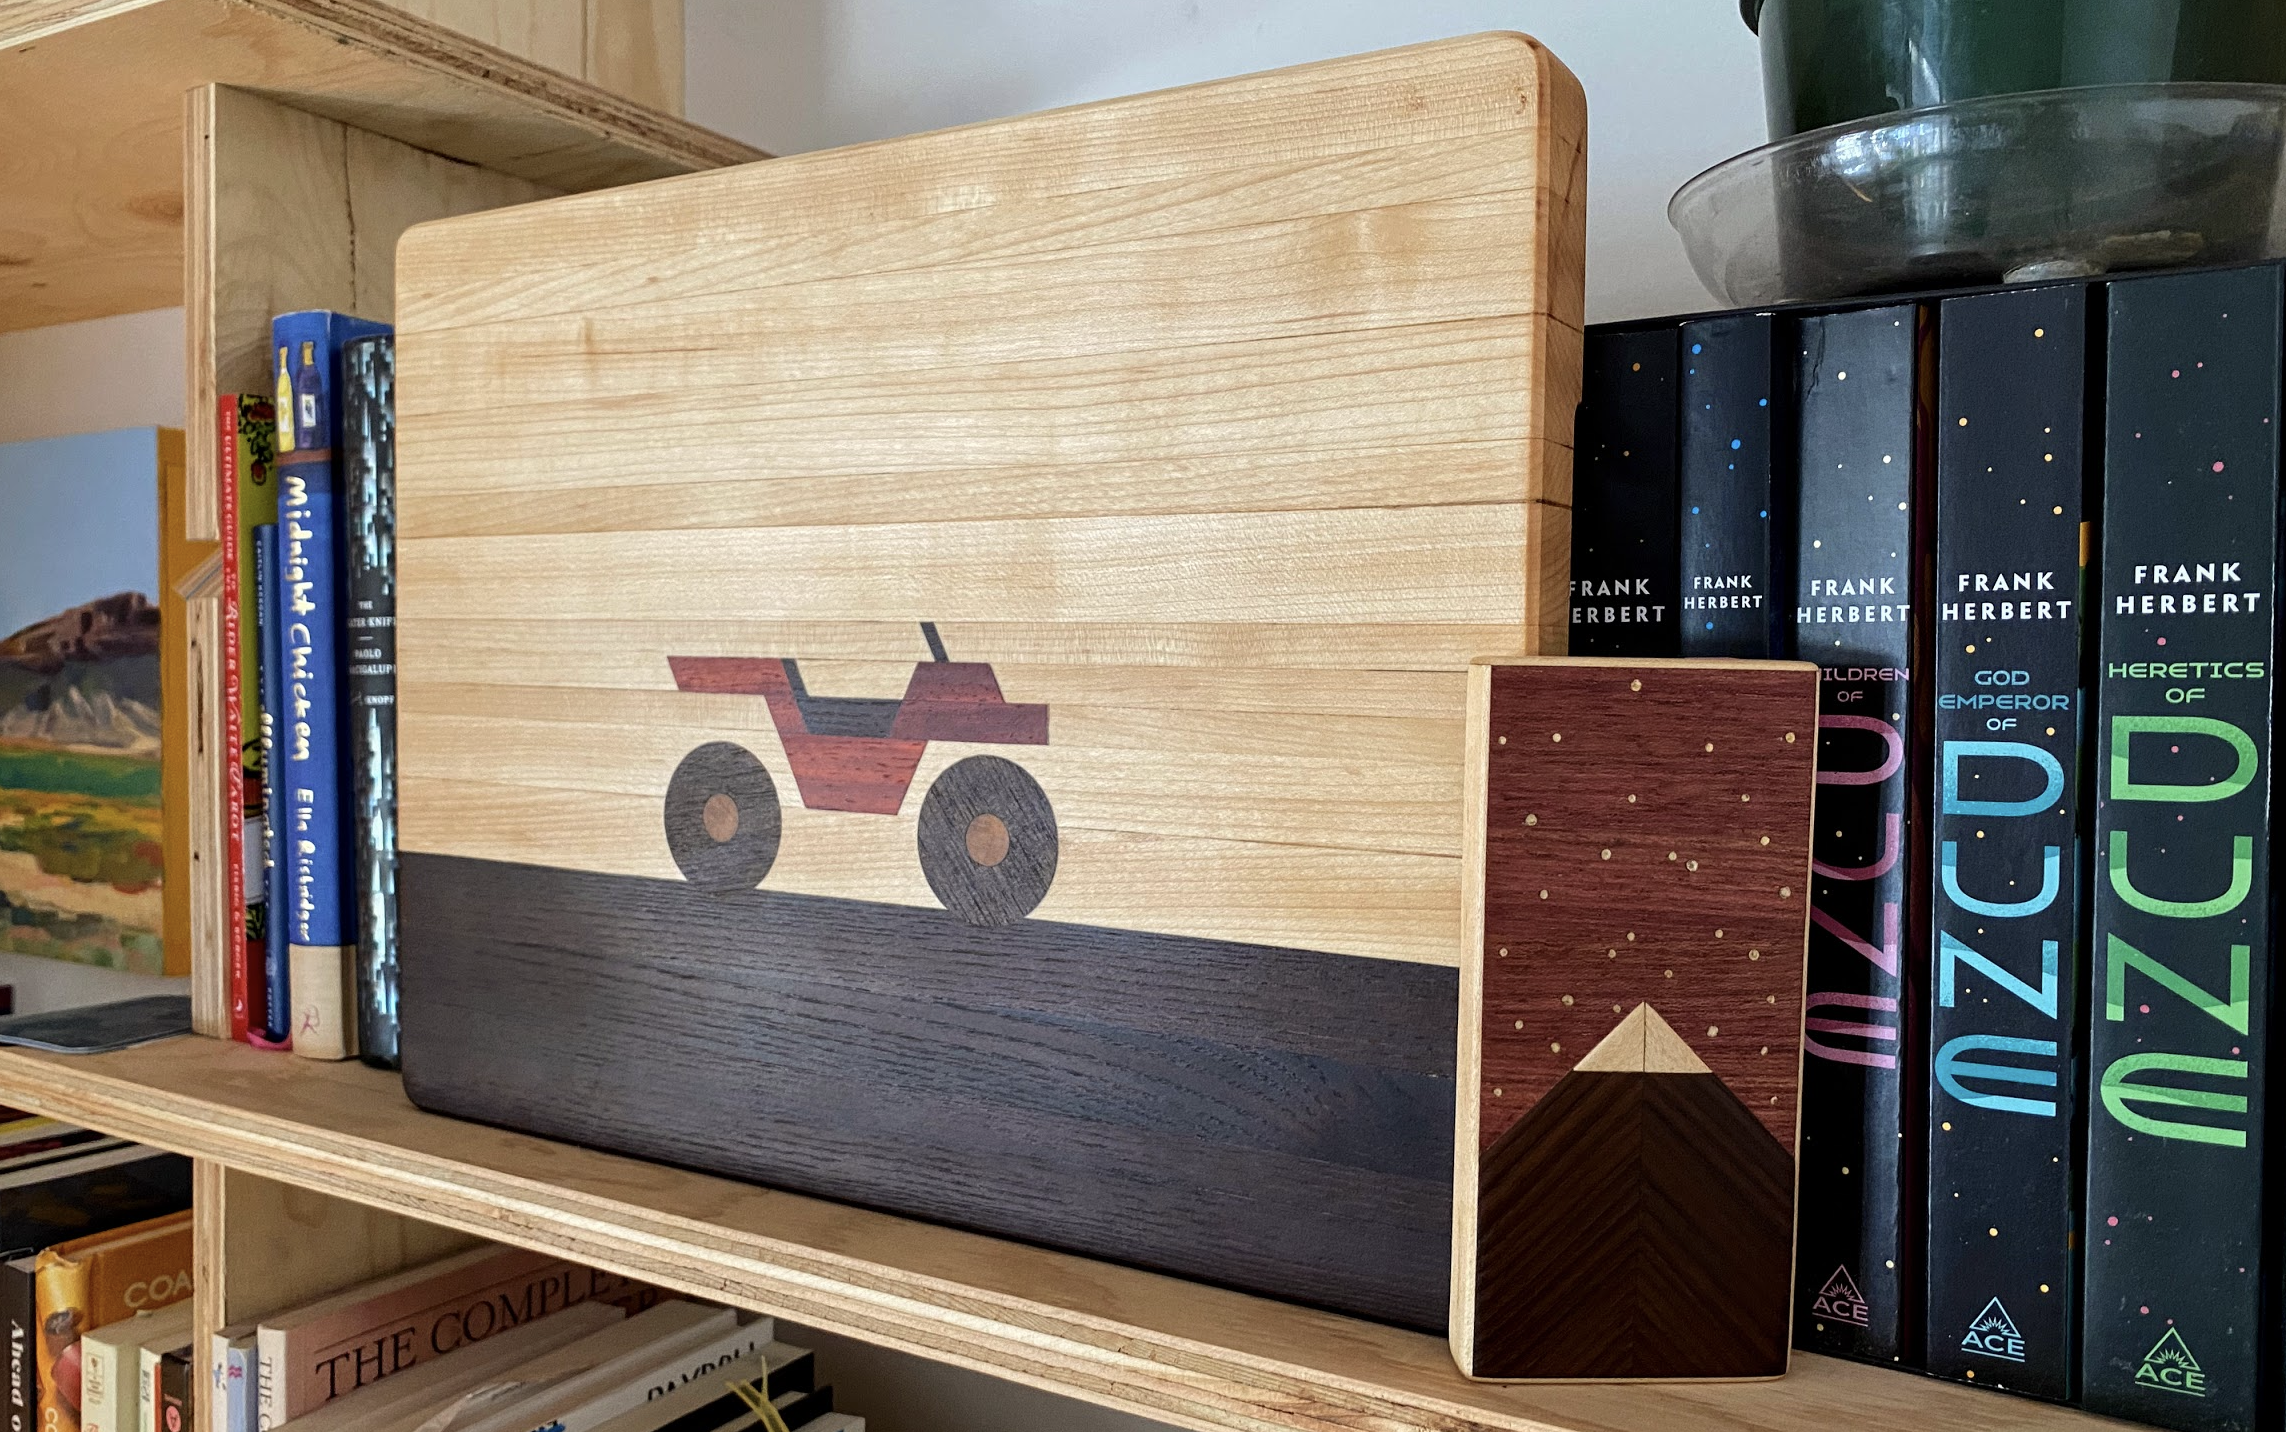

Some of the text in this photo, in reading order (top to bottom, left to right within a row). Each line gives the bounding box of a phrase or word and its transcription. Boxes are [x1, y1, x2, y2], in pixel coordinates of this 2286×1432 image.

[224, 435, 233, 510] ULTIMATE
[226, 514, 234, 560] GUIDE
[1693, 575, 1752, 589] FRANK
[1958, 571, 2055, 592] FRANK
[2134, 562, 2241, 584] FRANK
[1570, 578, 1650, 597] FRANK
[1811, 577, 1895, 596] FRANK
[358, 600, 374, 610] THE
[1684, 595, 1763, 609] HERBERT
[1942, 600, 2072, 621] HERBERT
[2116, 592, 2261, 615] HERBERT
[285, 475, 316, 761] Midnight Chicken
[1572, 605, 1665, 623] ERBERT
[1796, 604, 1910, 623] HERBERT
[354, 648, 382, 659] PAOLO
[1819, 667, 1909, 681] ILDREN
[1974, 669, 2030, 686] GOD
[2108, 662, 2265, 679] HERETICS
[364, 695, 395, 706] KNOPF
[1837, 691, 1863, 702] OF
[1938, 694, 2070, 711] EMPEROR
[2165, 687, 2206, 704] OF
[225, 597, 242, 841] RIDER WAITE TAROT
[1986, 717, 2017, 731] OF
[296, 788, 316, 942] Ella Risbridger
[1934, 740, 2066, 1118] DUNE
[2100, 715, 2260, 1148] DUNE
[1811, 1296, 1869, 1322] ACE
[1962, 1330, 2026, 1357] ACE
[11, 1319, 24, 1407] Ahead
[315, 1327, 417, 1401] THE
[259, 1356, 272, 1407] THE
[2134, 1362, 2206, 1390] ACE
